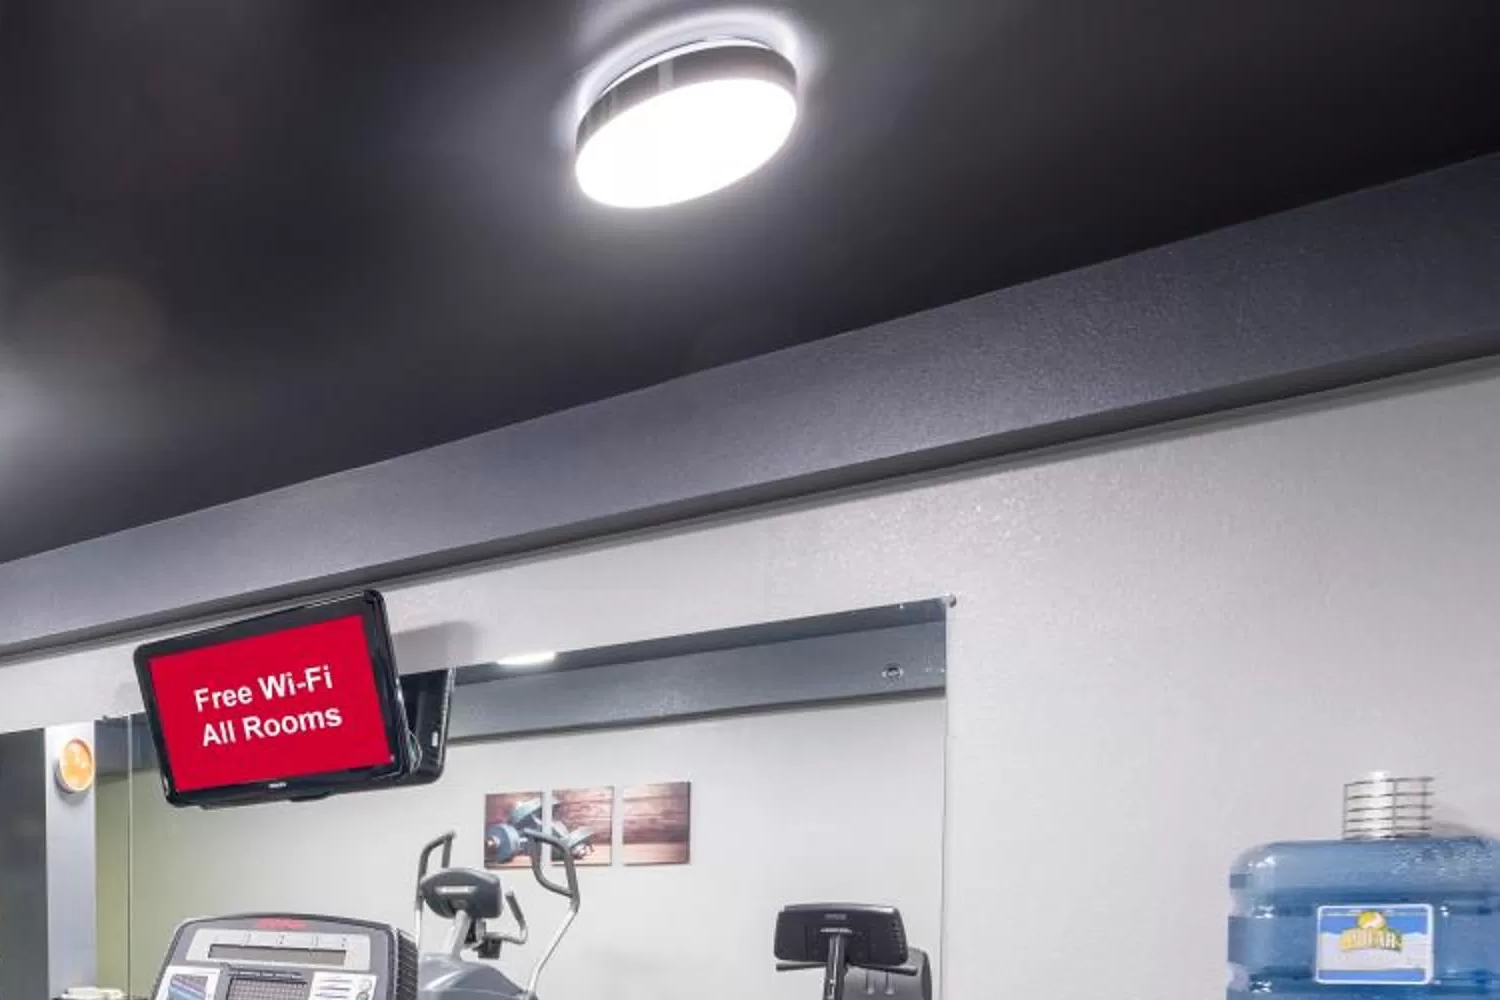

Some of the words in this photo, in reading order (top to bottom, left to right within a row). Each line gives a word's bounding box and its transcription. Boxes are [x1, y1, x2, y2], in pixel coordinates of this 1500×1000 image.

[194, 686, 252, 712] Free
[257, 664, 333, 700] Wi-Fi
[202, 720, 236, 747] All
[242, 707, 343, 741] Rooms
